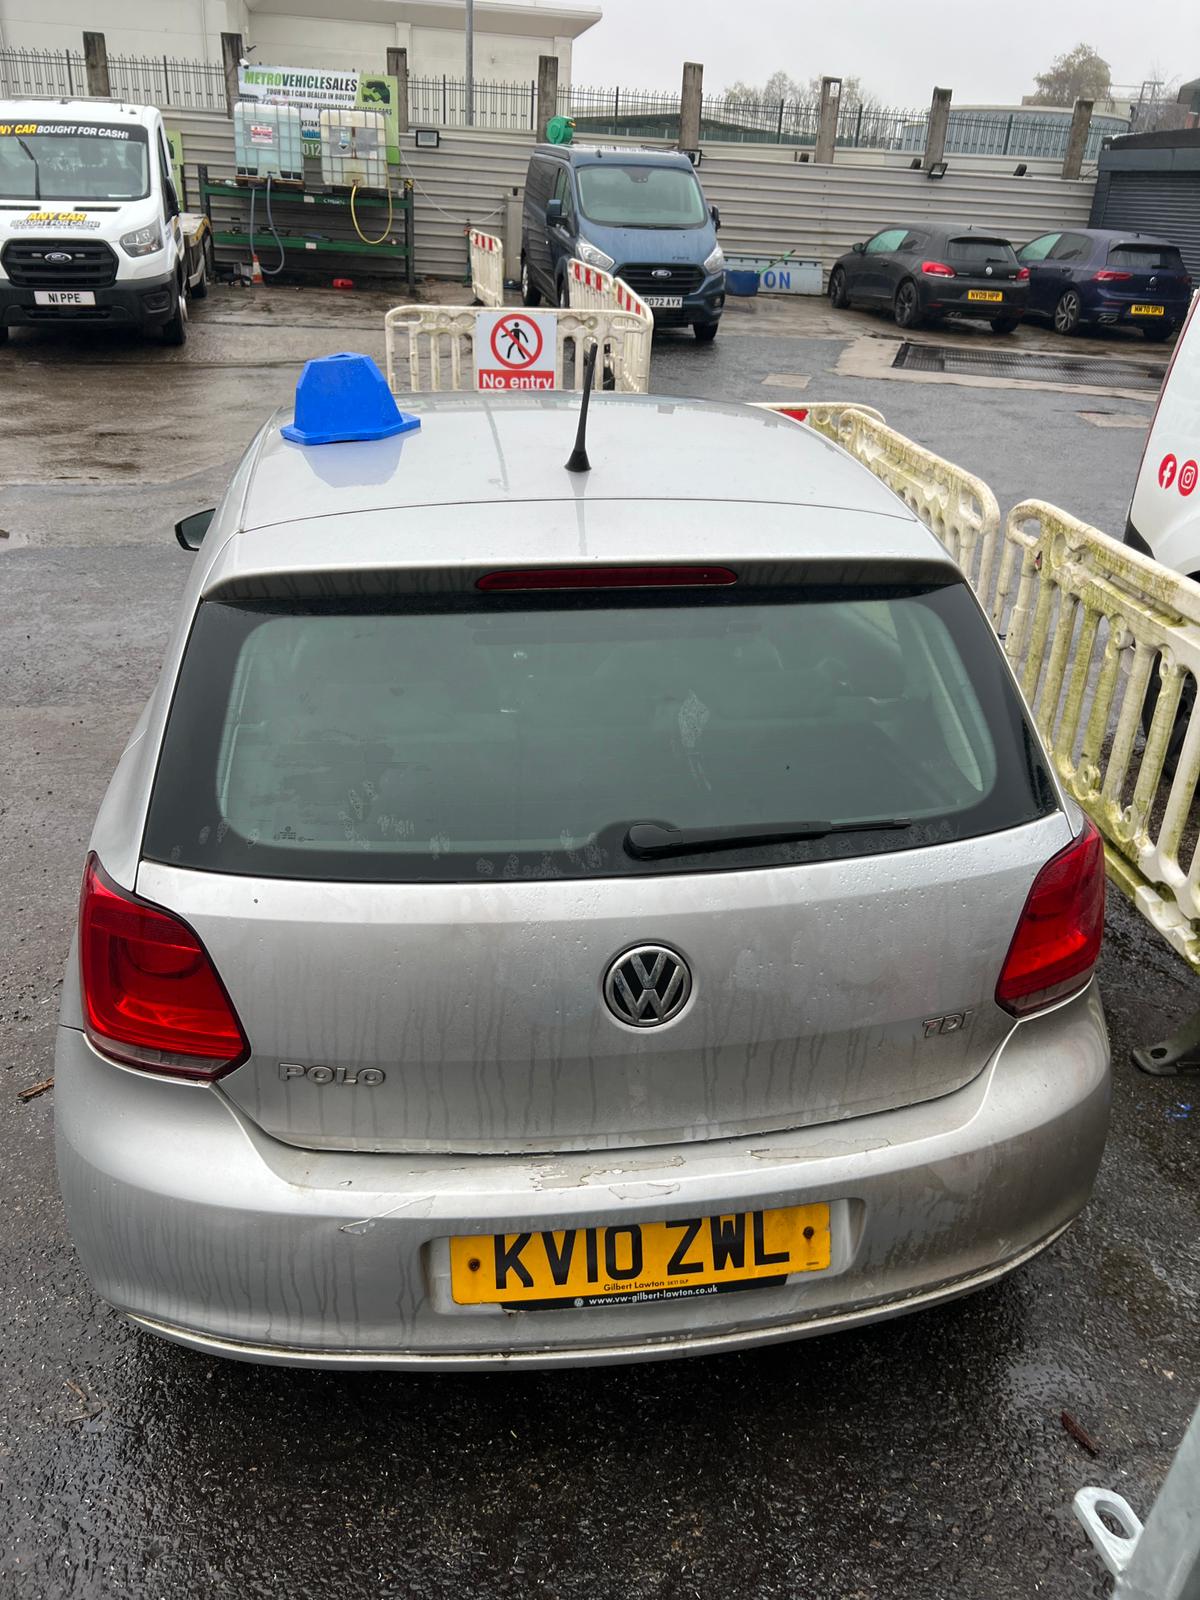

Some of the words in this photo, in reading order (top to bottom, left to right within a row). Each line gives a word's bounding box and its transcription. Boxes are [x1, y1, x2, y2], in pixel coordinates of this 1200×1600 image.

[244, 71, 357, 92] METROVEHICLESALES
[266, 88, 281, 96] YOUR
[307, 91, 327, 99] DEALER
[328, 92, 334, 100] IN
[335, 93, 355, 102] BOLTON
[15, 124, 37, 134] CAR
[37, 125, 76, 135] BOUGHT
[77, 126, 97, 136] FOR
[98, 128, 129, 139] CASH!
[26, 212, 55, 221] ANY
[57, 213, 87, 222] CAR
[60, 293, 81, 304] PPE
[666, 298, 681, 307] AYX
[482, 373, 505, 388] No
[510, 375, 552, 390] entry
[922, 1009, 974, 1038] TDI
[279, 1063, 385, 1086] POLO
[494, 1224, 643, 1289] KV10
[665, 1210, 790, 1275] ZWL
[604, 1281, 632, 1292] Gilbert
[634, 1279, 665, 1289] Lawton
[589, 1285, 718, 1305] www.vw-gilbert-lawton.co.uk
